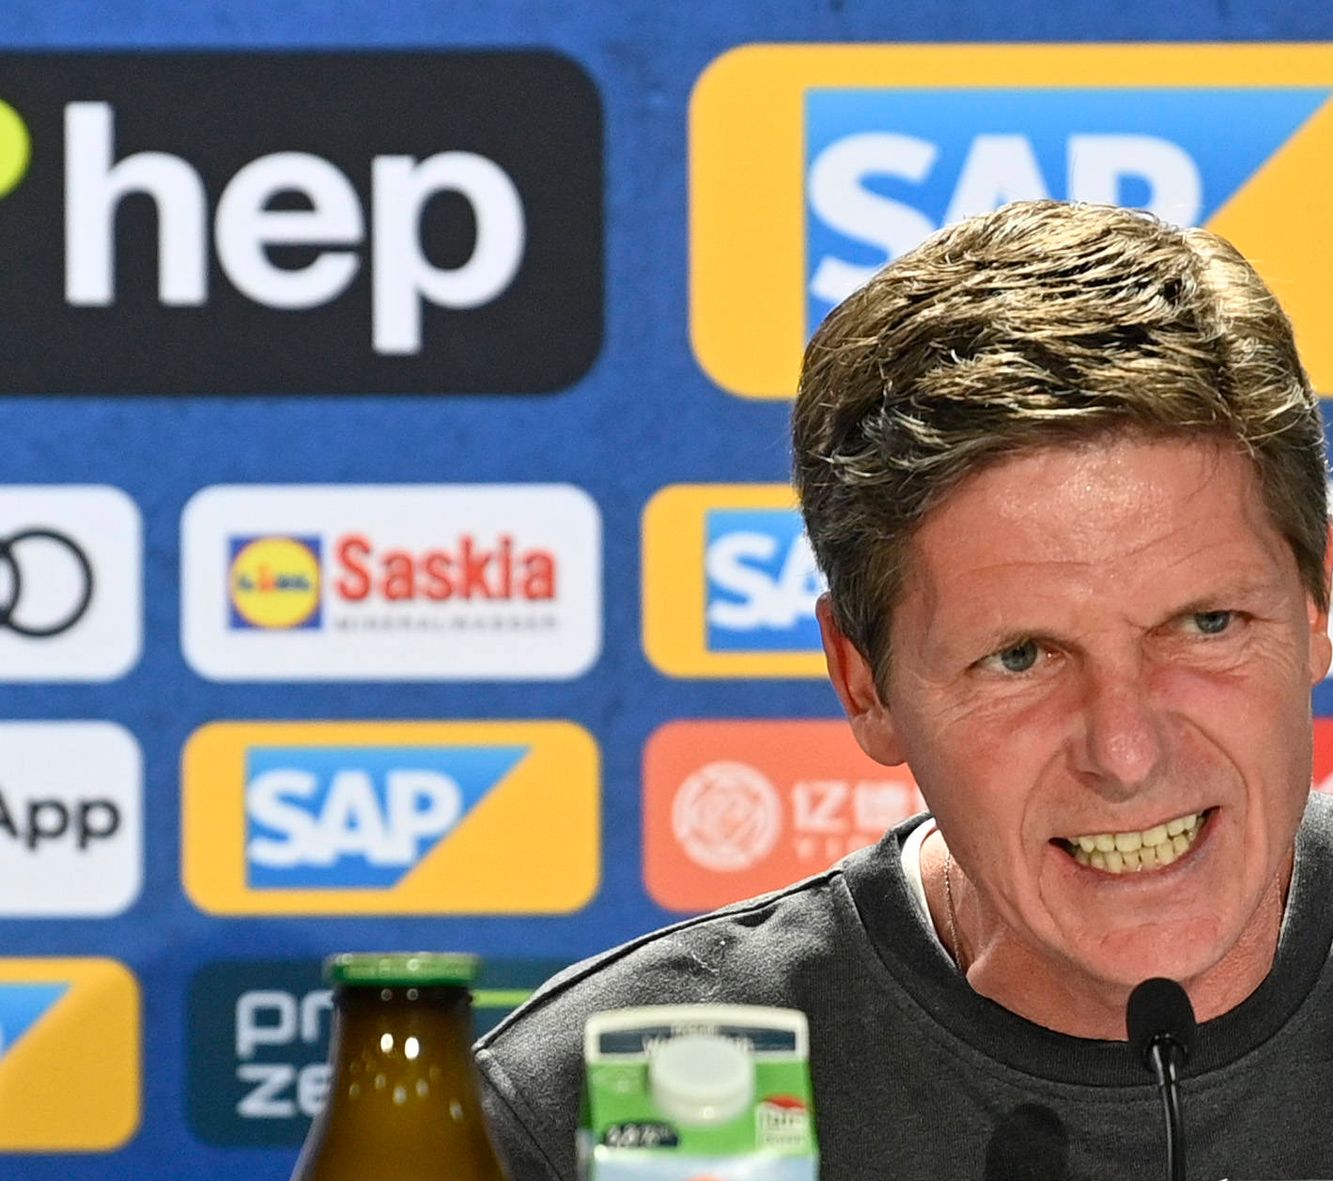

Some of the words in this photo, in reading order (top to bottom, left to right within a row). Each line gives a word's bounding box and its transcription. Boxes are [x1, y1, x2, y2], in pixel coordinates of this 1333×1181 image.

[64, 101, 526, 354] hep
[335, 534, 557, 602] Saskia
[707, 532, 828, 630] SA
[246, 769, 463, 866] SAP
